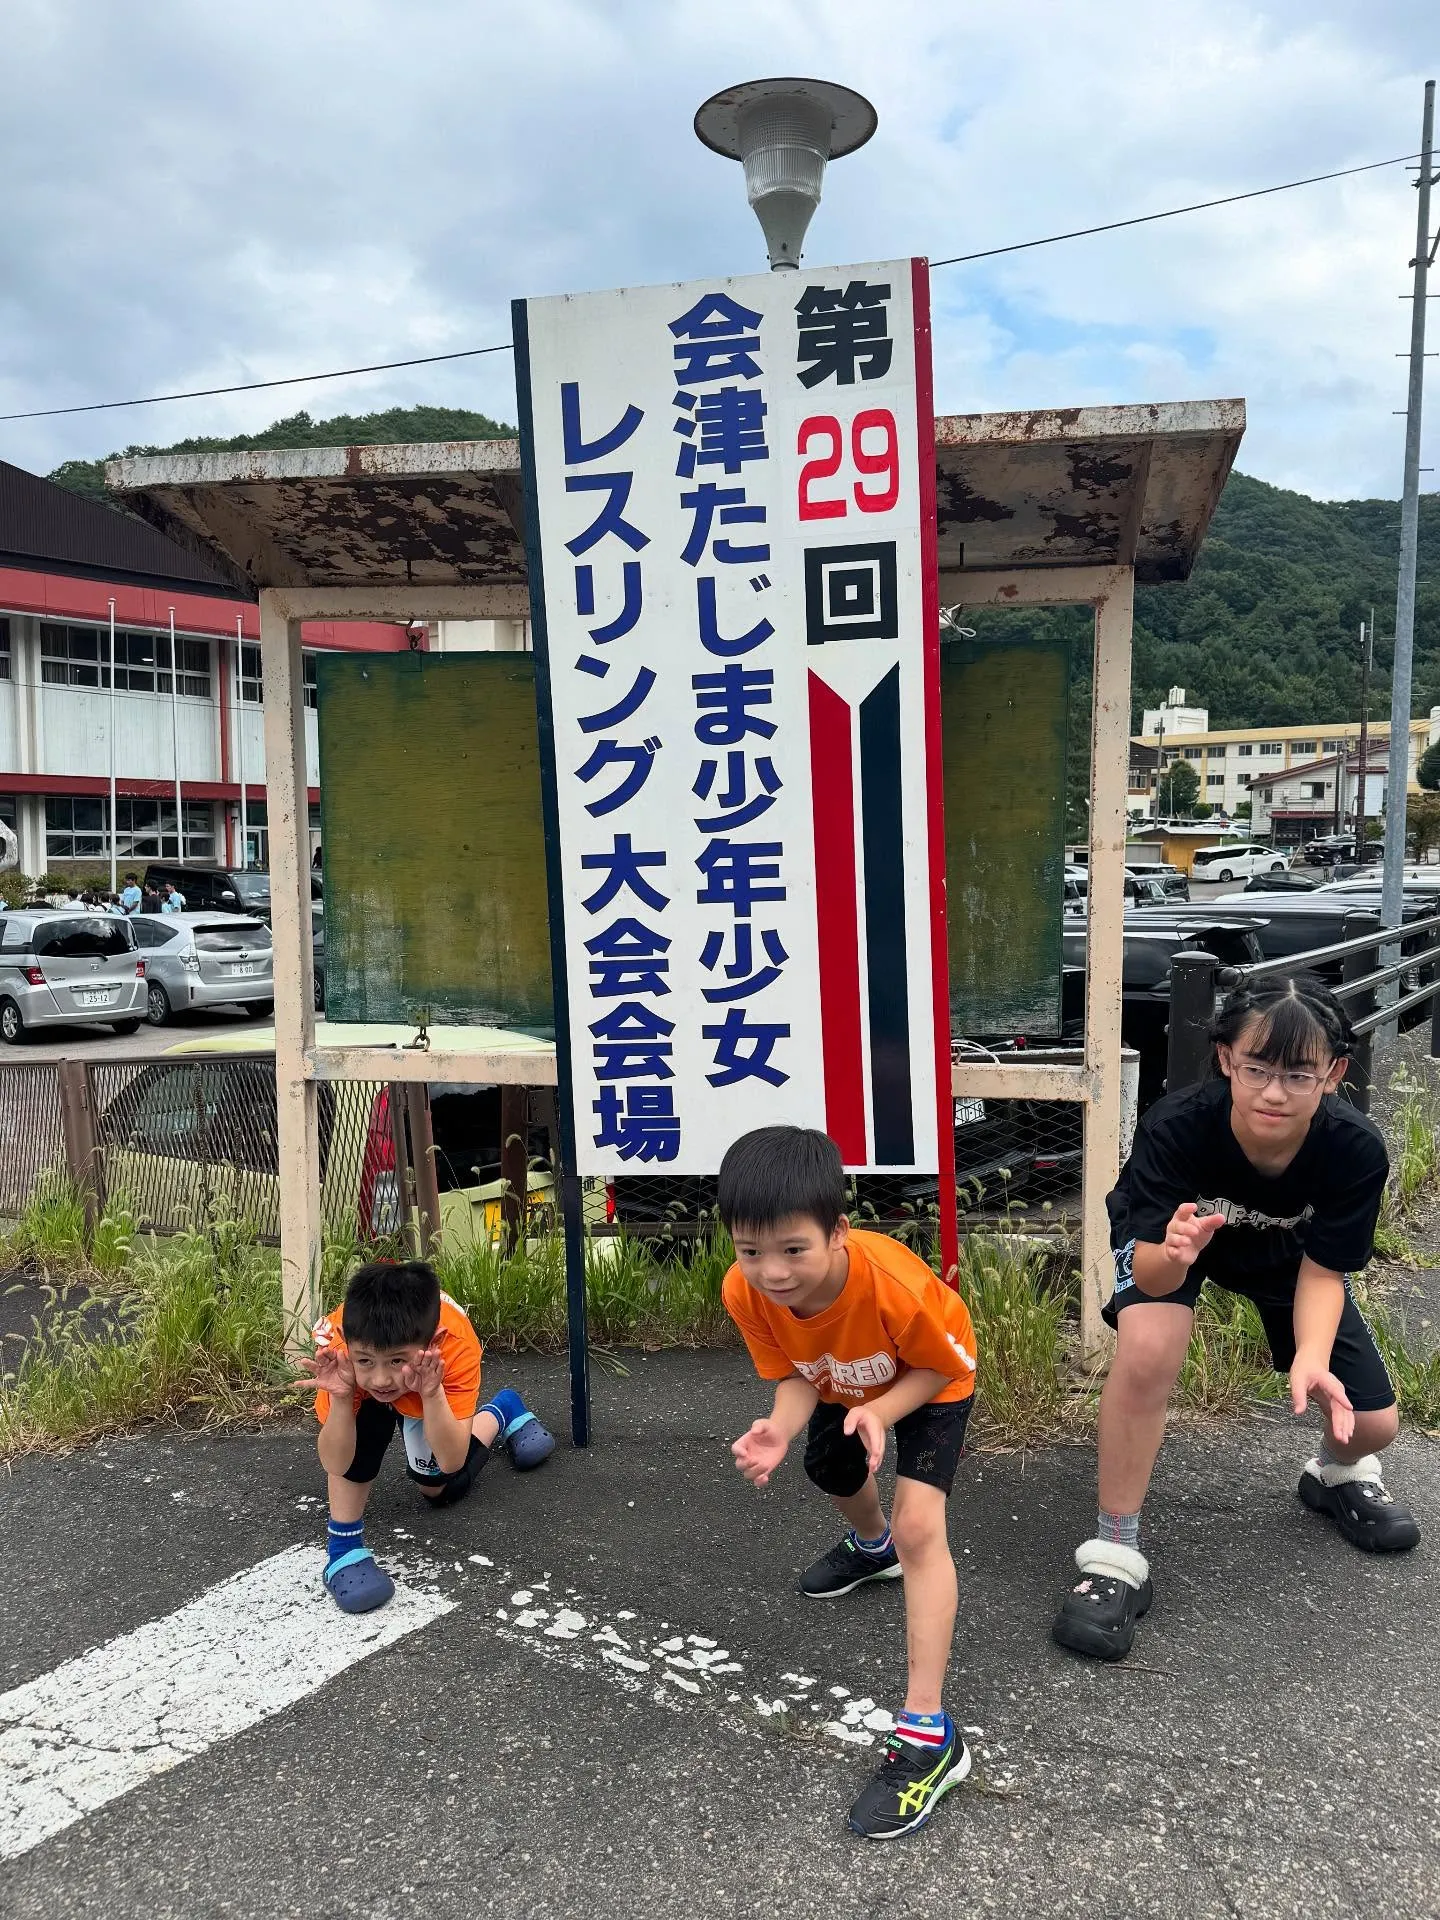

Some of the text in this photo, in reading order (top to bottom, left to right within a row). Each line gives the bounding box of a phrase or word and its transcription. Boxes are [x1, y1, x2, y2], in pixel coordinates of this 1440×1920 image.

[667, 292, 791, 1088] 会津たじま少年少女
